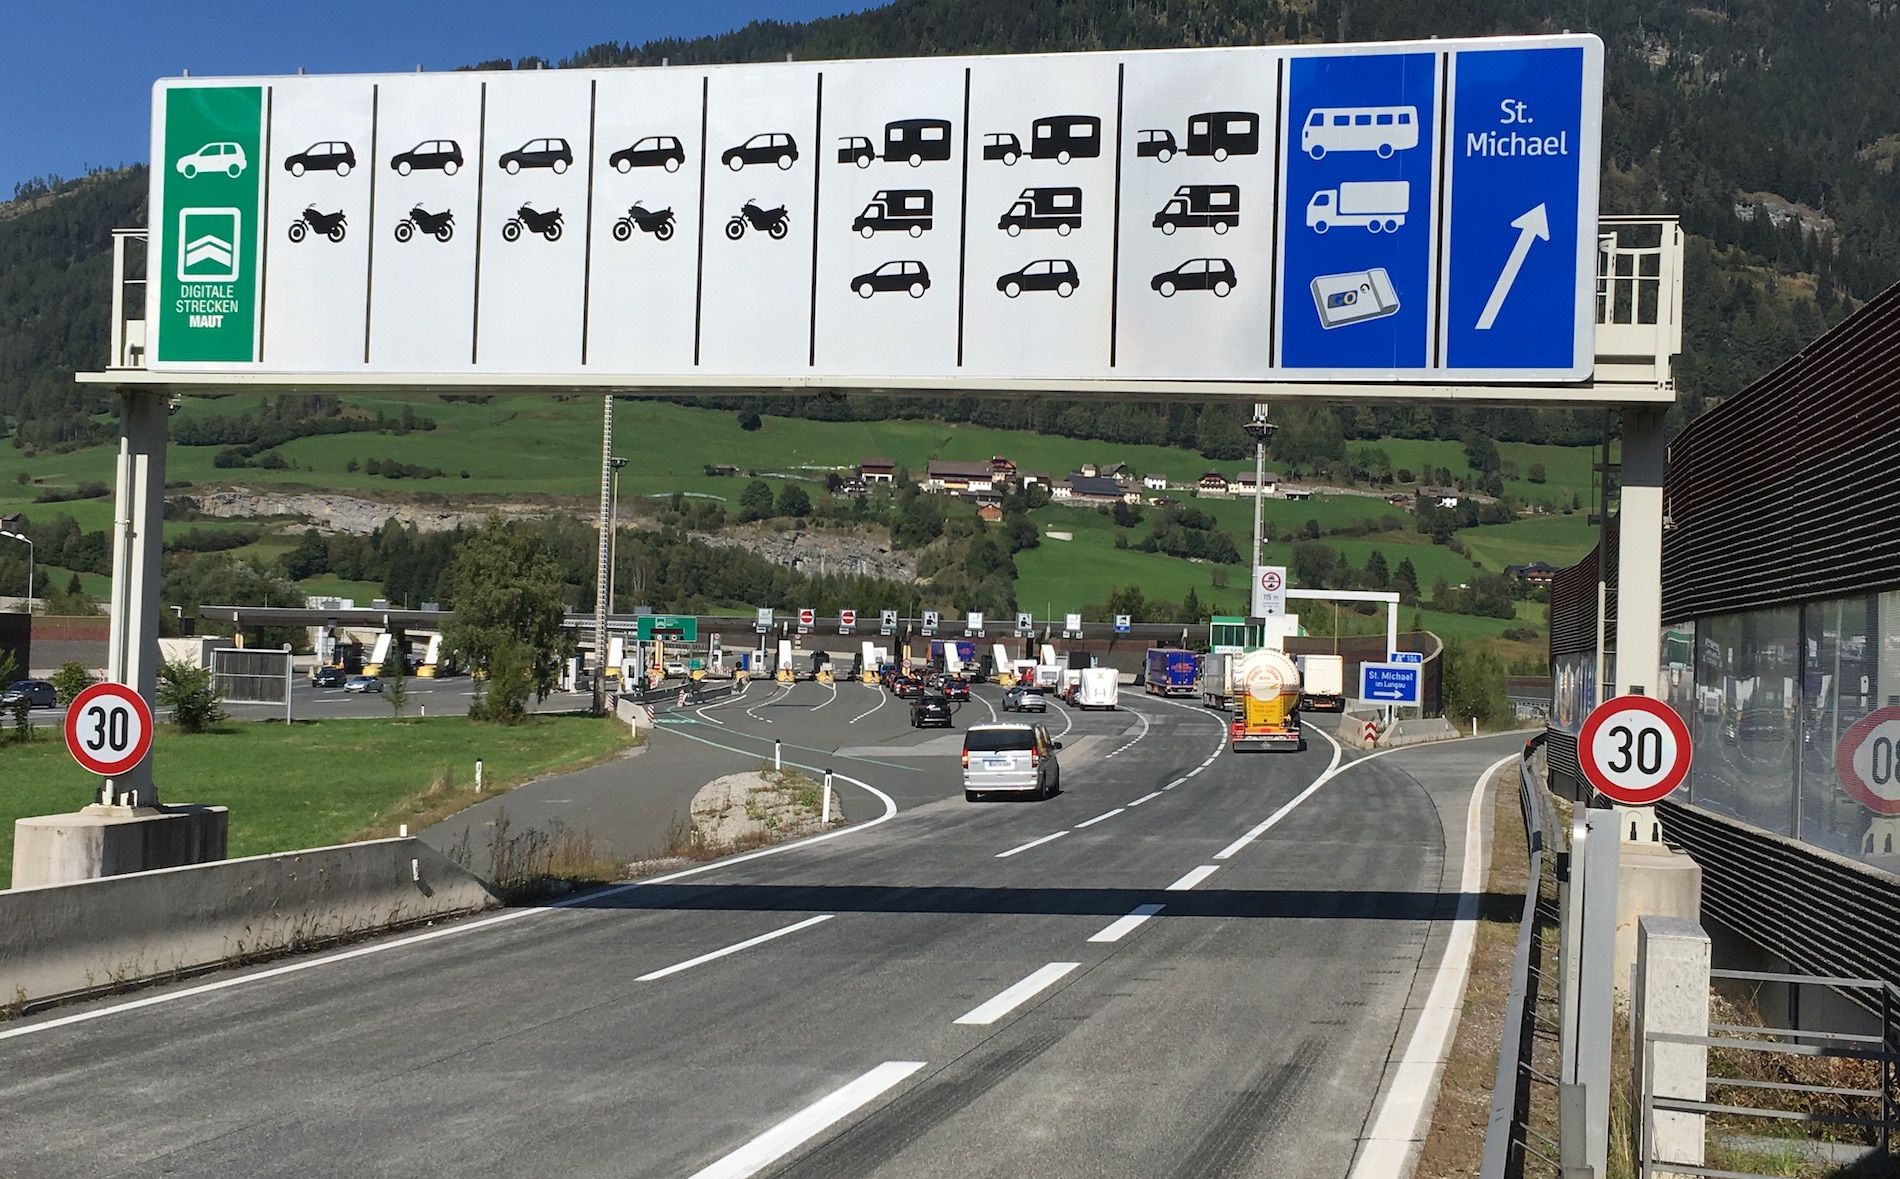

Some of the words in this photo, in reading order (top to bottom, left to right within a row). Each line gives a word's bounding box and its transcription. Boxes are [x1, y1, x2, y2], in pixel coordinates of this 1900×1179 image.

[1500, 98, 1534, 124] St.
[1466, 130, 1568, 157] Michael
[180, 285, 234, 298] DIGITALE
[175, 300, 239, 313] STRECKEN
[189, 315, 224, 328] MAUT
[1368, 671, 1380, 680] St.
[1381, 671, 1413, 681] Michael
[1383, 681, 1406, 689] Lungau
[87, 706, 128, 752] 30
[1608, 725, 1662, 775] 30
